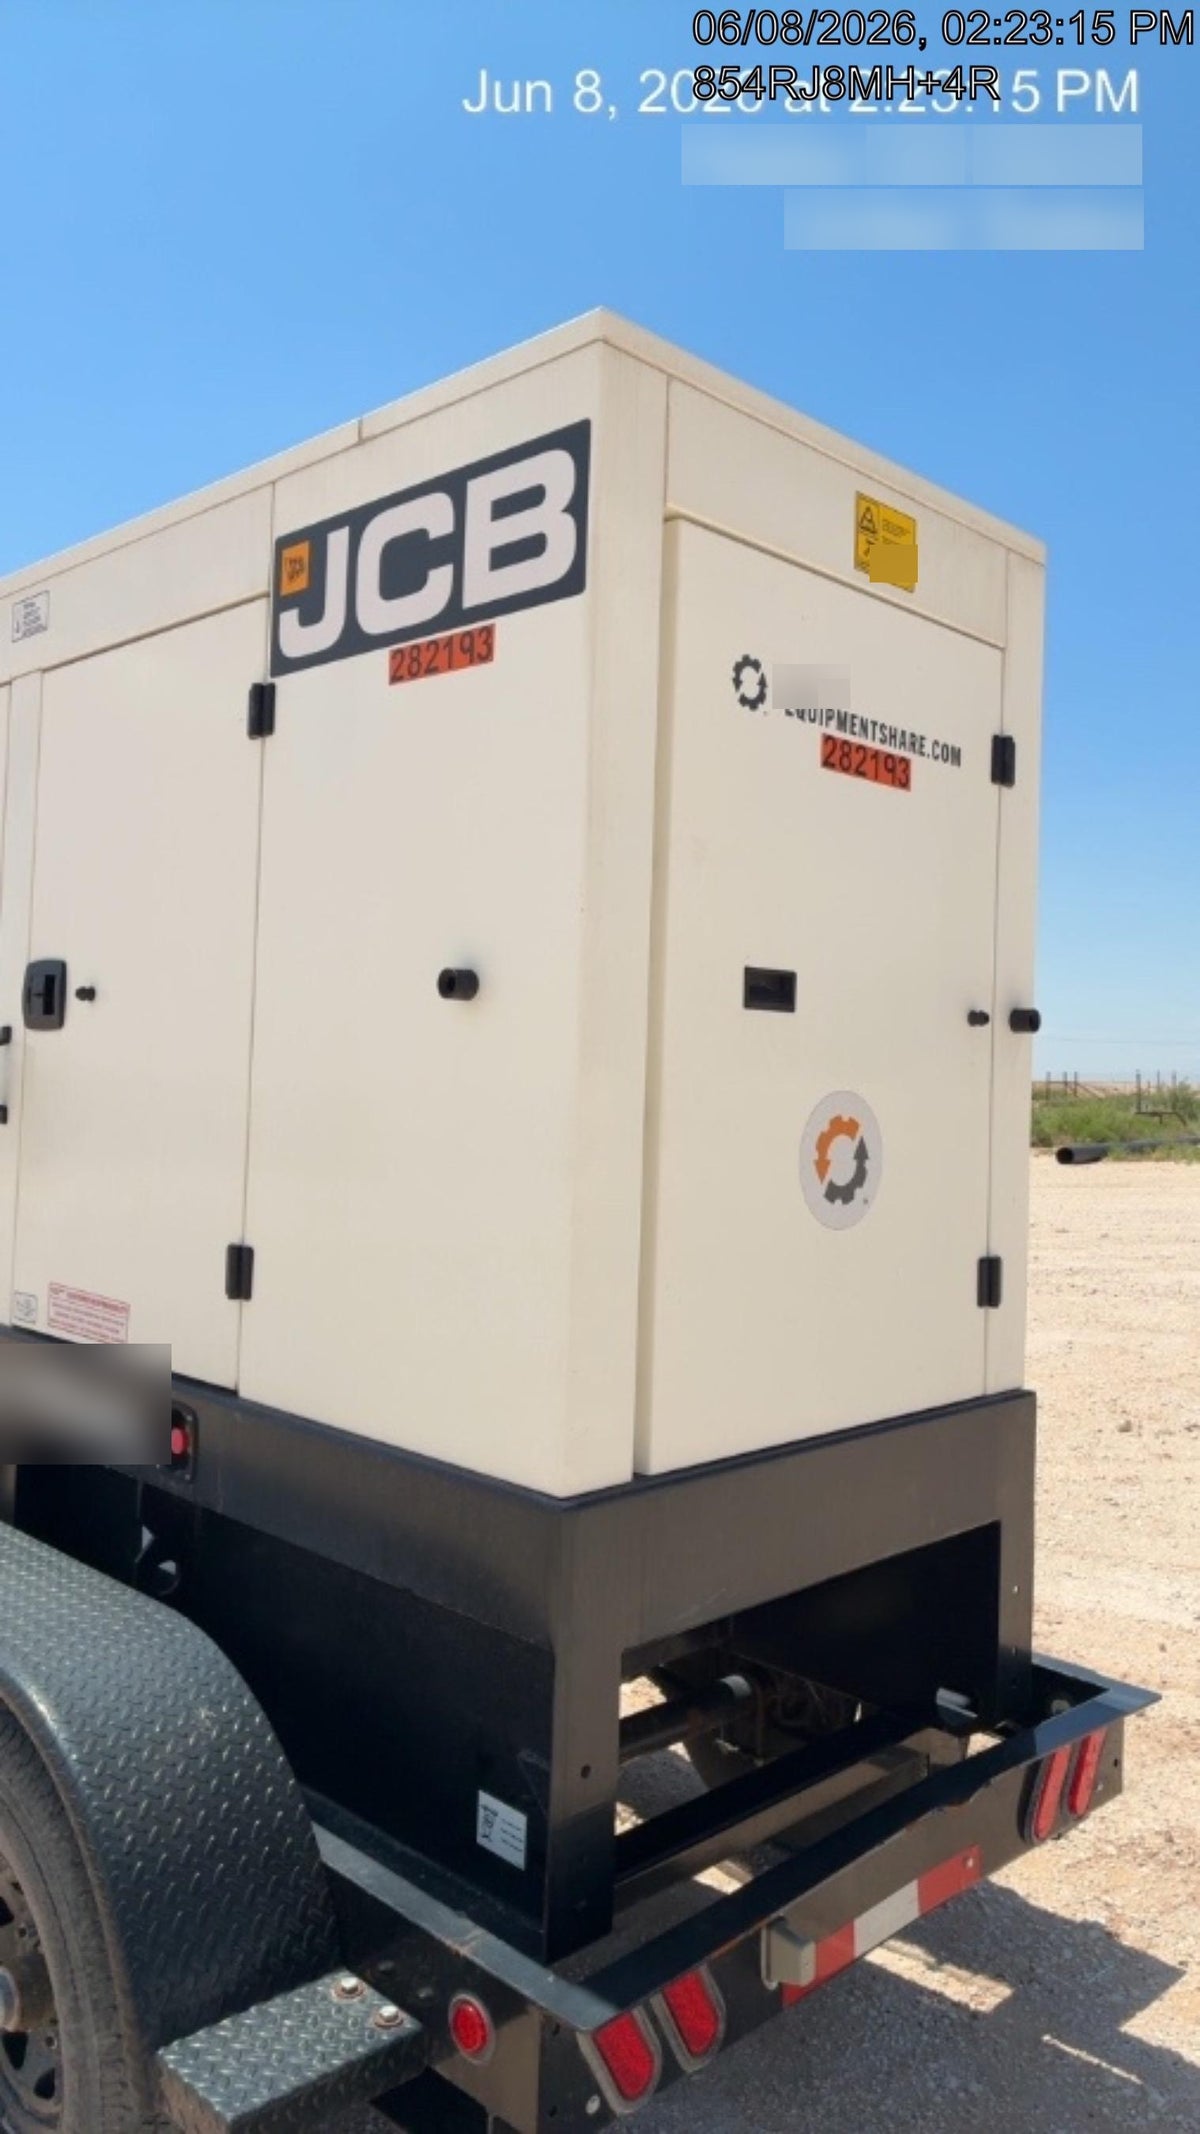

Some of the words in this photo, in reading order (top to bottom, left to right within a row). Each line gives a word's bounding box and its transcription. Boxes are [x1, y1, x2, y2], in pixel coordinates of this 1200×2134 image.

[279, 448, 577, 659] JCB
[390, 625, 494, 683] 282193
[822, 736, 910, 788] 282193
